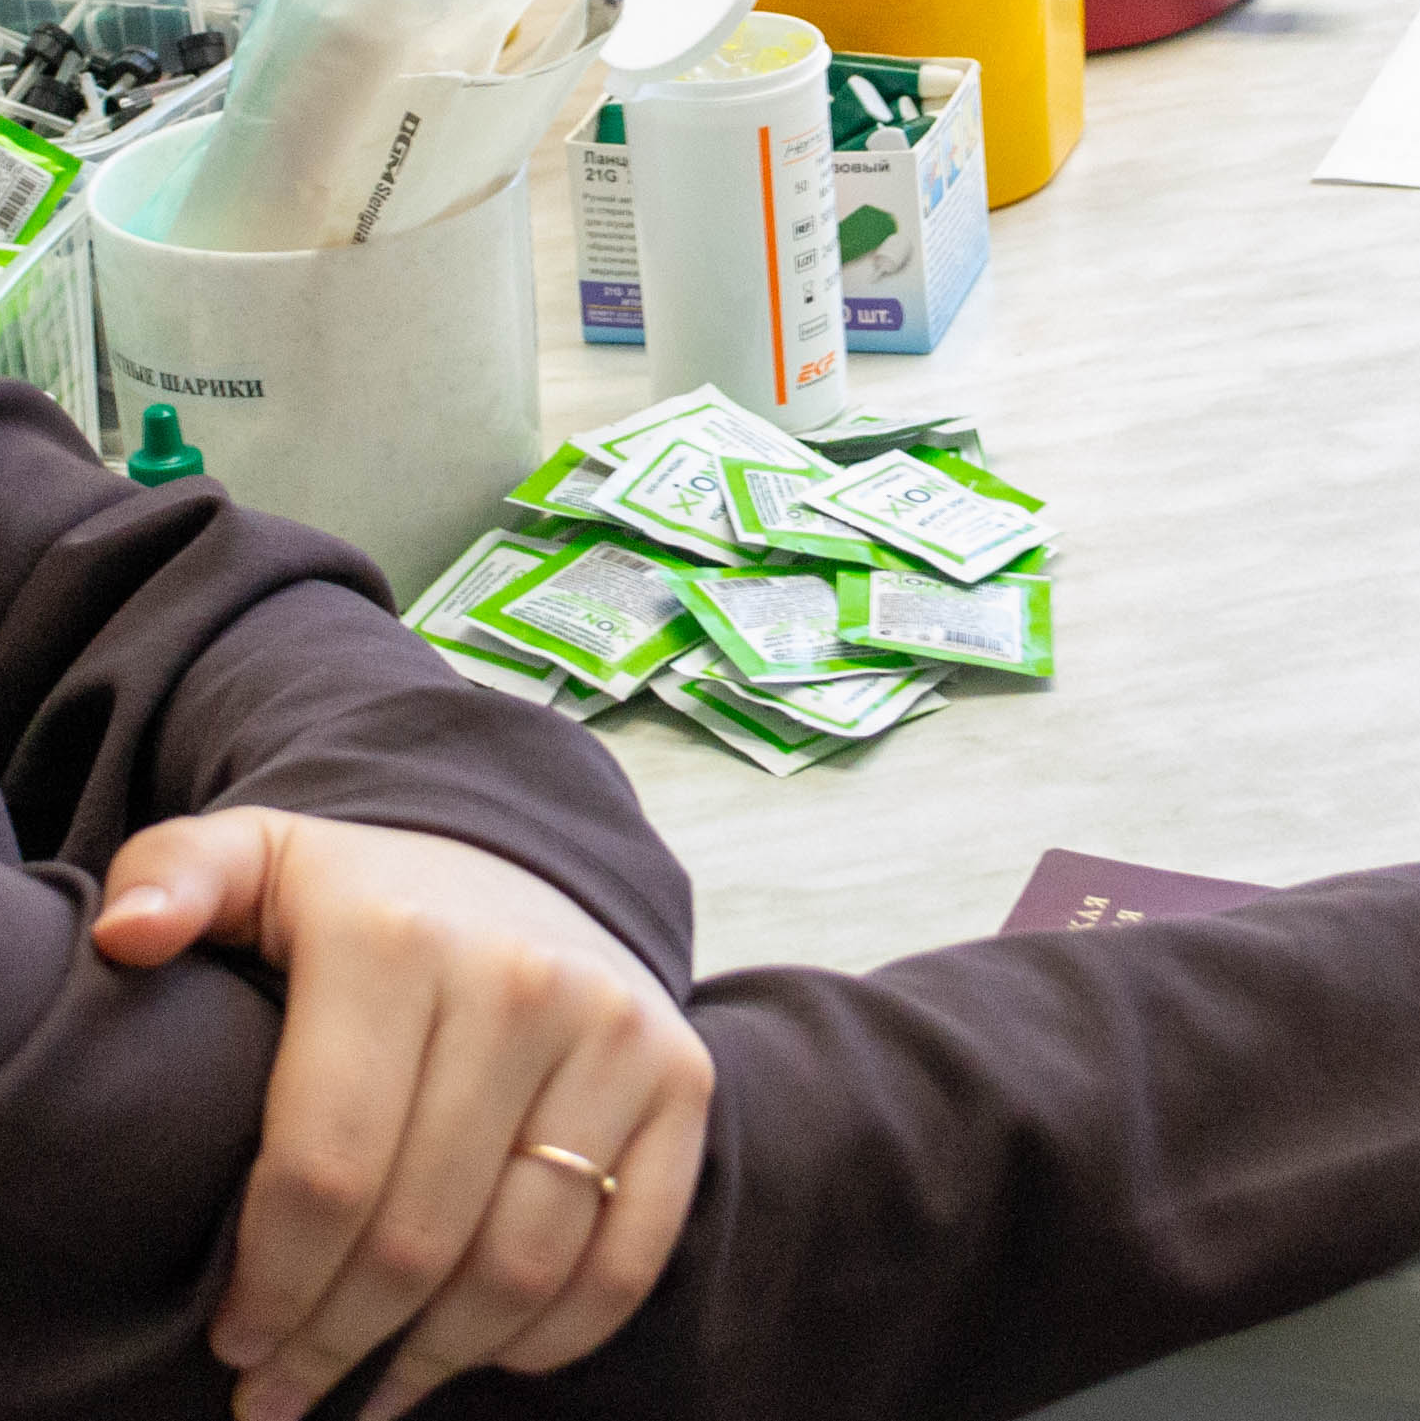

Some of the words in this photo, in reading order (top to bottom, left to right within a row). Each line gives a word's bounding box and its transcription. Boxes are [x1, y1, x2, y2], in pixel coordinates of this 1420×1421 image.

[584, 168, 617, 183] 21G
[857, 309, 893, 324] шт.
[159, 372, 265, 398] ШАРИКИ
